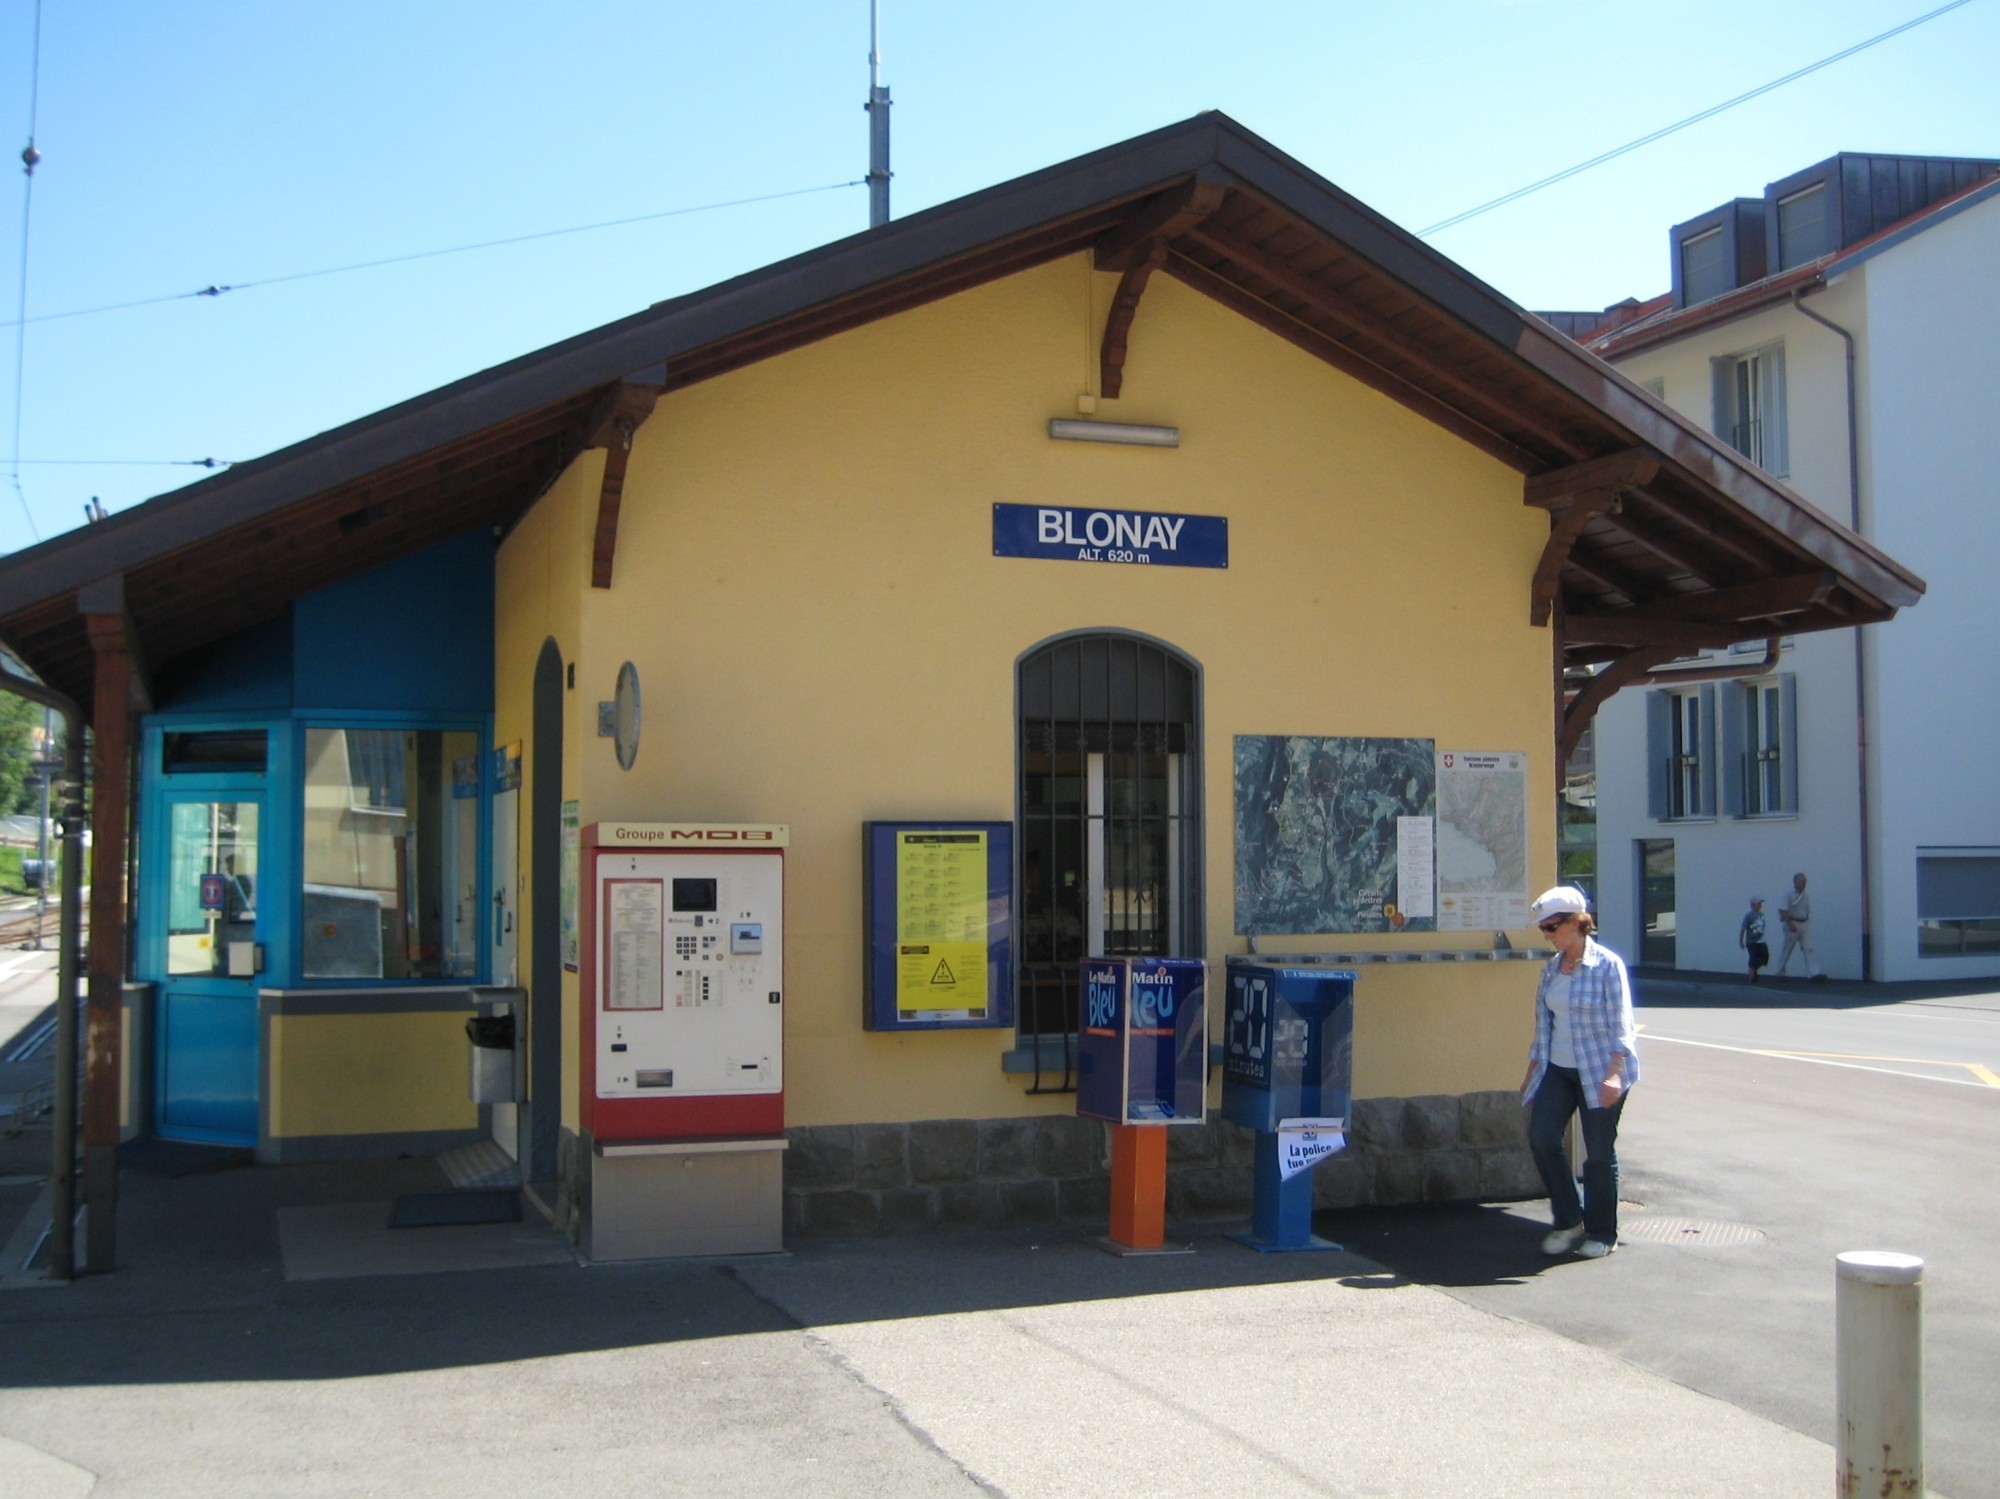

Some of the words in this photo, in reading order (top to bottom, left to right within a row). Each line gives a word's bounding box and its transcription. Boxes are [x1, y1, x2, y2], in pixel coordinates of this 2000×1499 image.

[1038, 509, 1185, 550] BLONAY
[1078, 548, 1103, 561] ALT.
[1108, 549, 1133, 563] 620
[1138, 554, 1150, 563] m
[616, 828, 665, 842] Groupe
[671, 830, 773, 841] MOB
[1089, 970, 1098, 983] Le
[1098, 966, 1116, 985] Matin
[1132, 967, 1174, 985] Matin
[1089, 983, 1116, 1028] Bleu
[1231, 976, 1268, 1059] 20
[1229, 1058, 1265, 1078] minutes
[1290, 1144, 1301, 1157] La
[1303, 1143, 1332, 1159] police
[1287, 1158, 1304, 1169] tue
